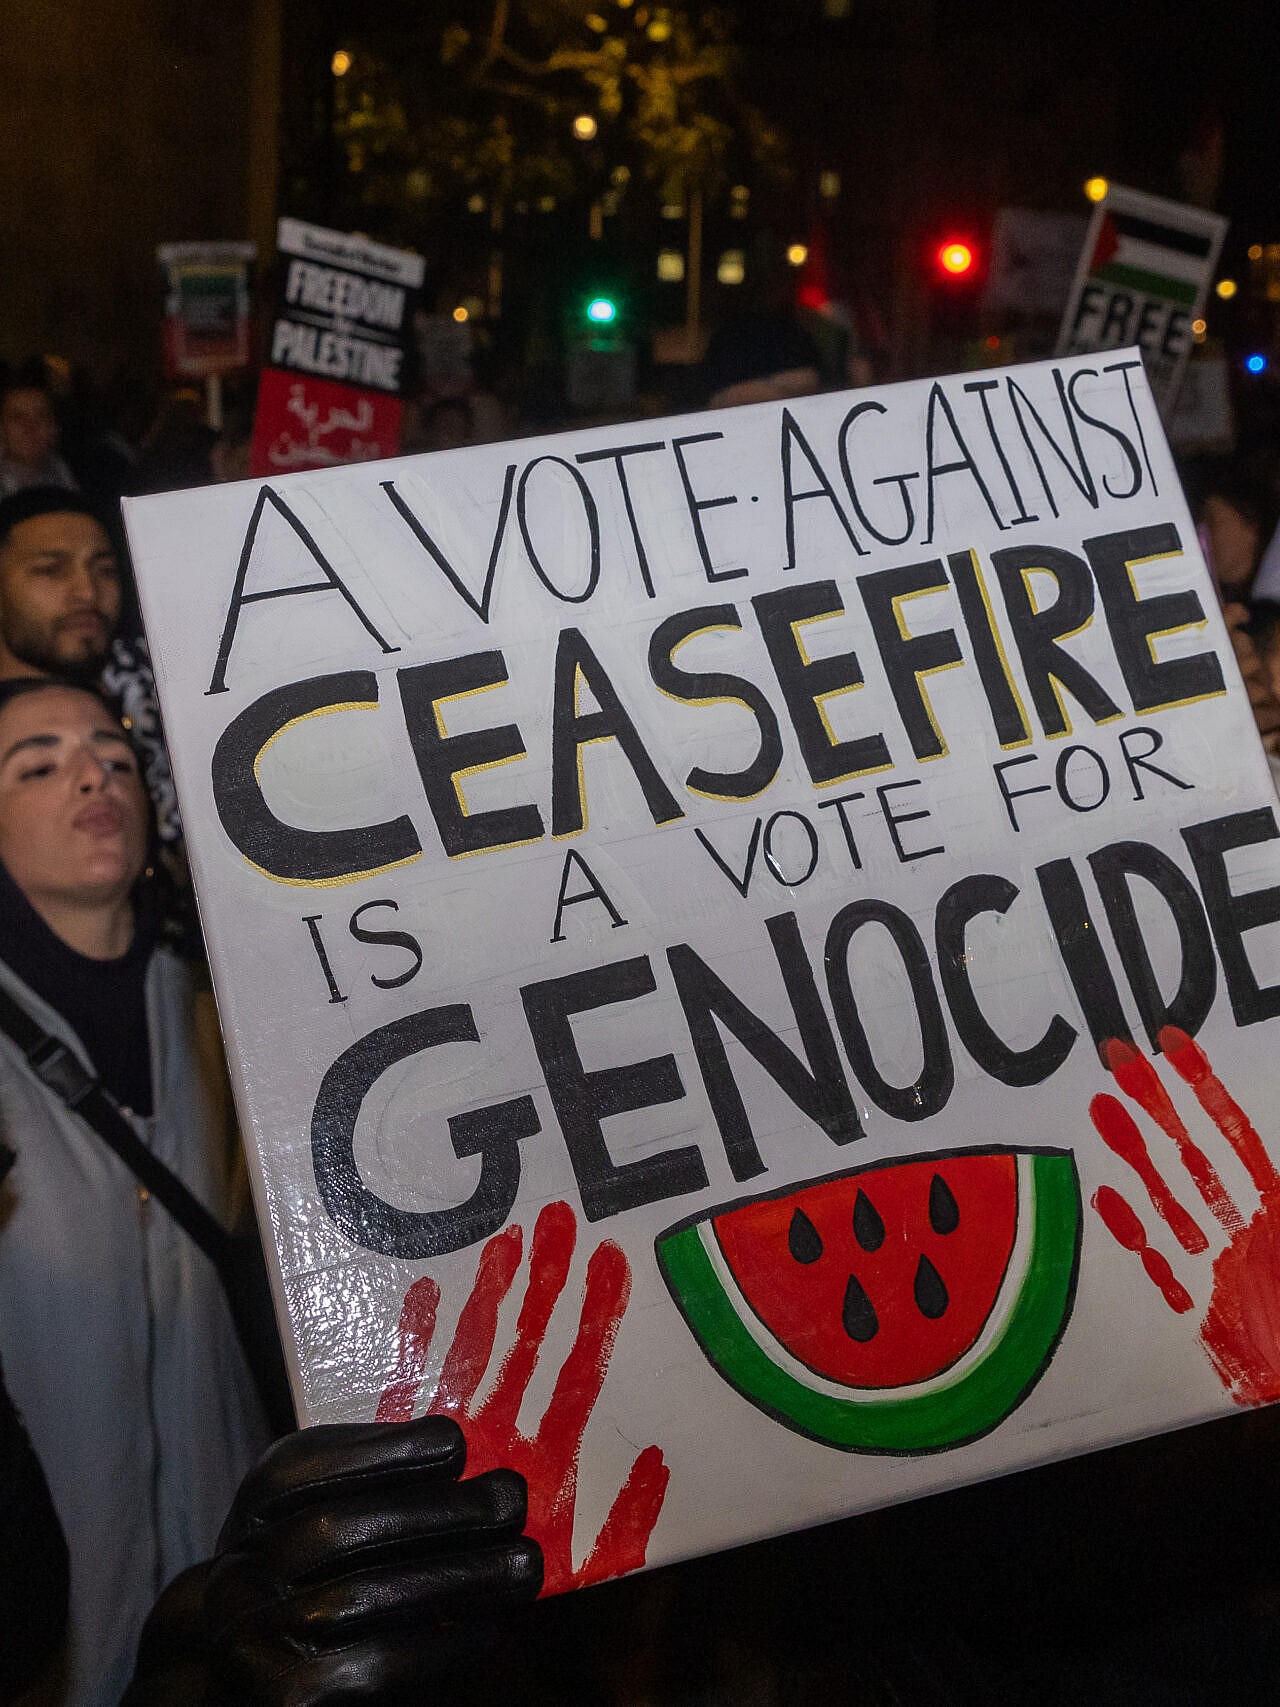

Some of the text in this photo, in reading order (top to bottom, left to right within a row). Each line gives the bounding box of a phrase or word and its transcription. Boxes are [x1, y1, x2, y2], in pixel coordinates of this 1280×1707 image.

[271, 318, 405, 391] PALESTINE
[1072, 284, 1190, 356] FREE
[204, 360, 1159, 695] A VOTE AGAINST
[211, 521, 1227, 889] CEASEFIRE
[302, 727, 1196, 1003] IS A VOTE FOR
